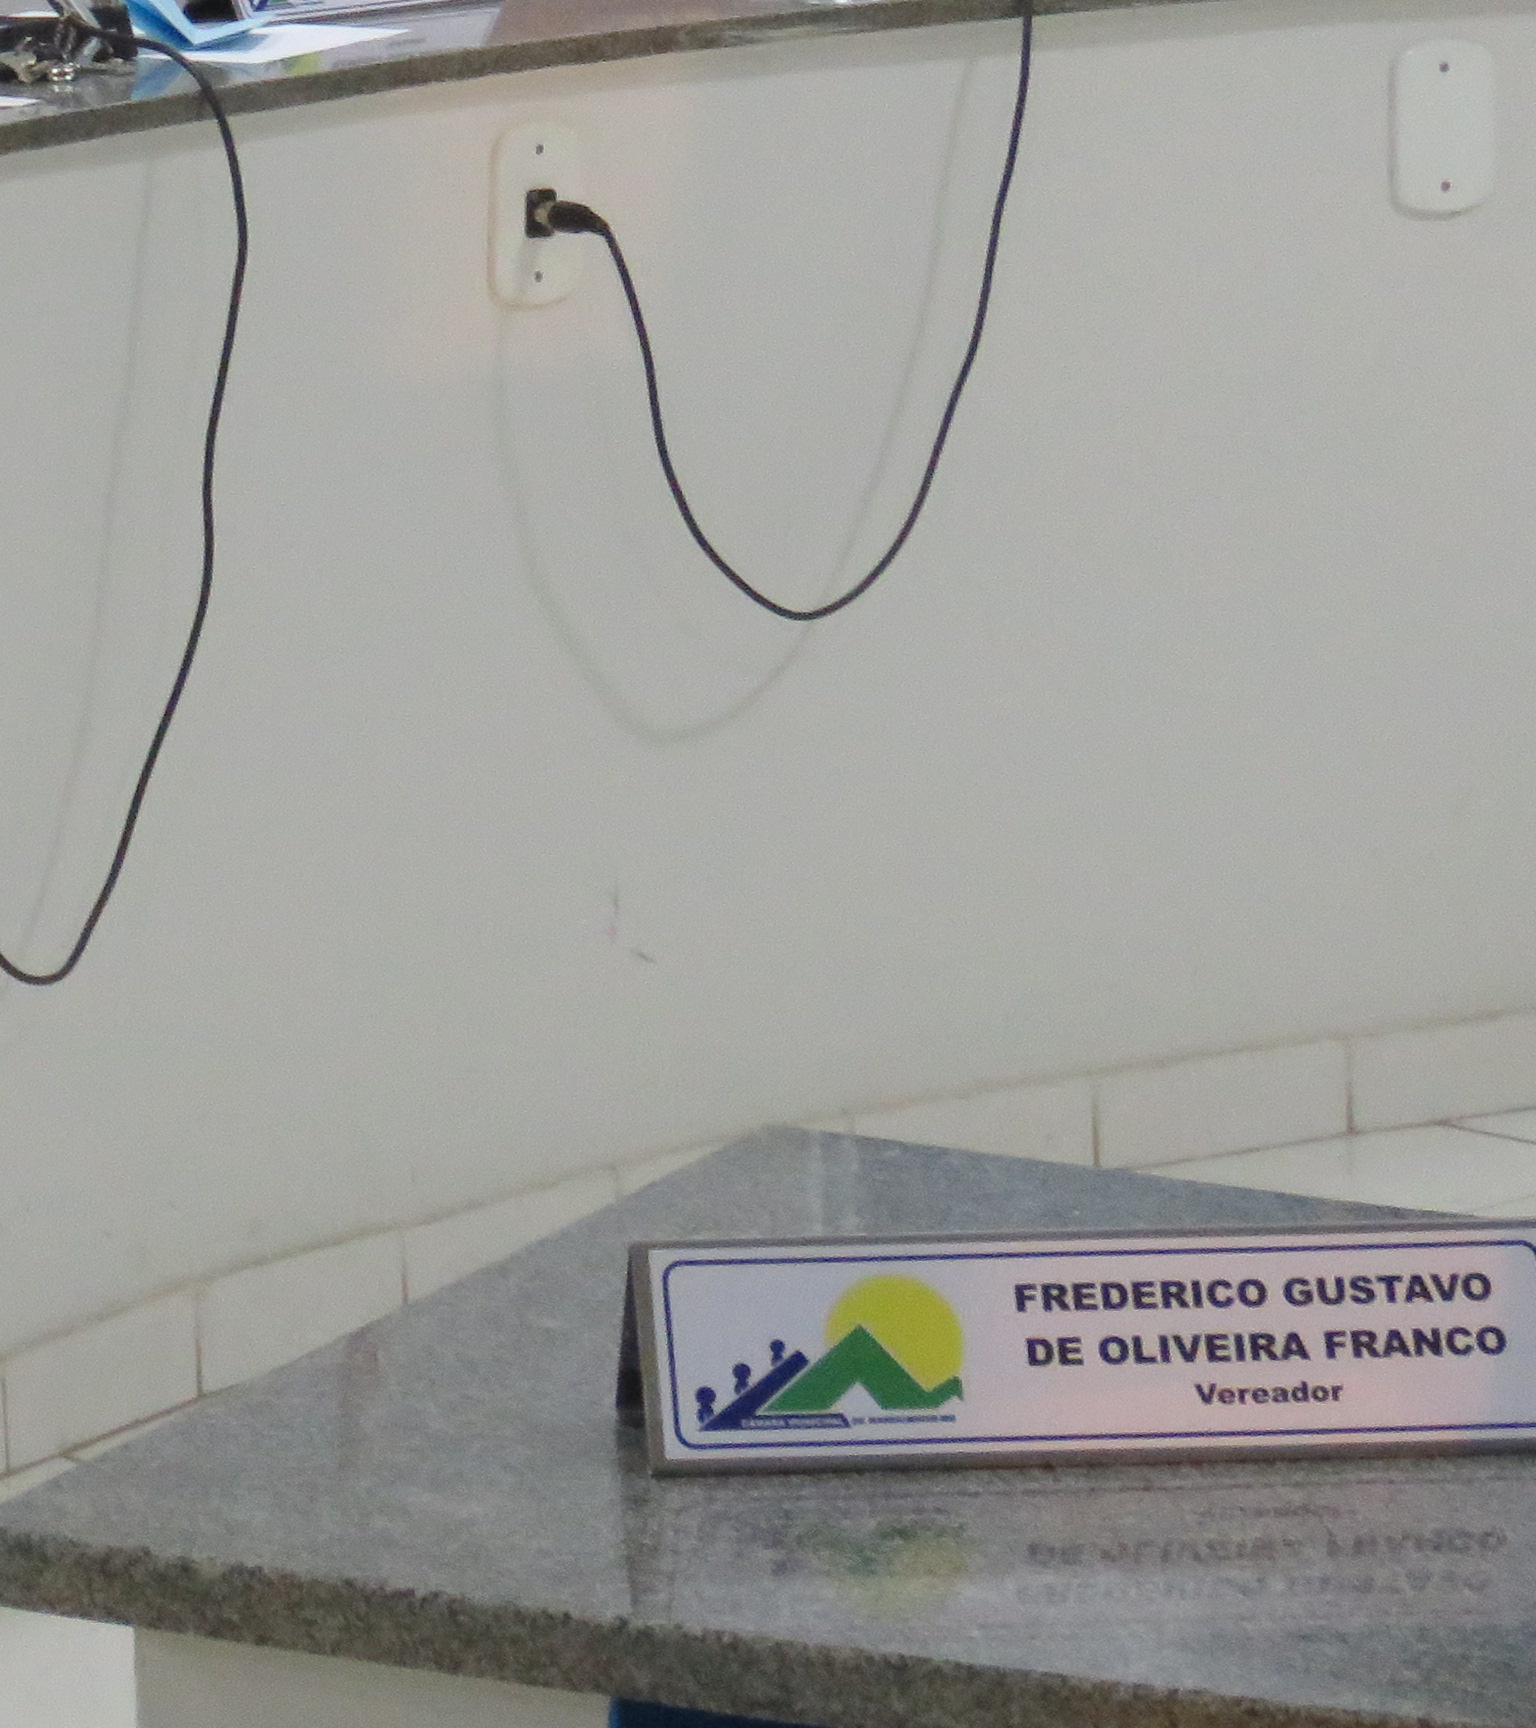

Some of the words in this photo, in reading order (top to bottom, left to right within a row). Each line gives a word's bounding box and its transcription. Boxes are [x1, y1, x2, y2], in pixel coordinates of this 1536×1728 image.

[1014, 1277, 1269, 1313] FREDERICO
[1283, 1271, 1492, 1307] GUSTAVO
[1025, 1335, 1084, 1367] DE
[1097, 1331, 1311, 1366] OLIVEIRA
[1324, 1325, 1508, 1359] FRANCO
[1194, 1380, 1344, 1406] Vereador
